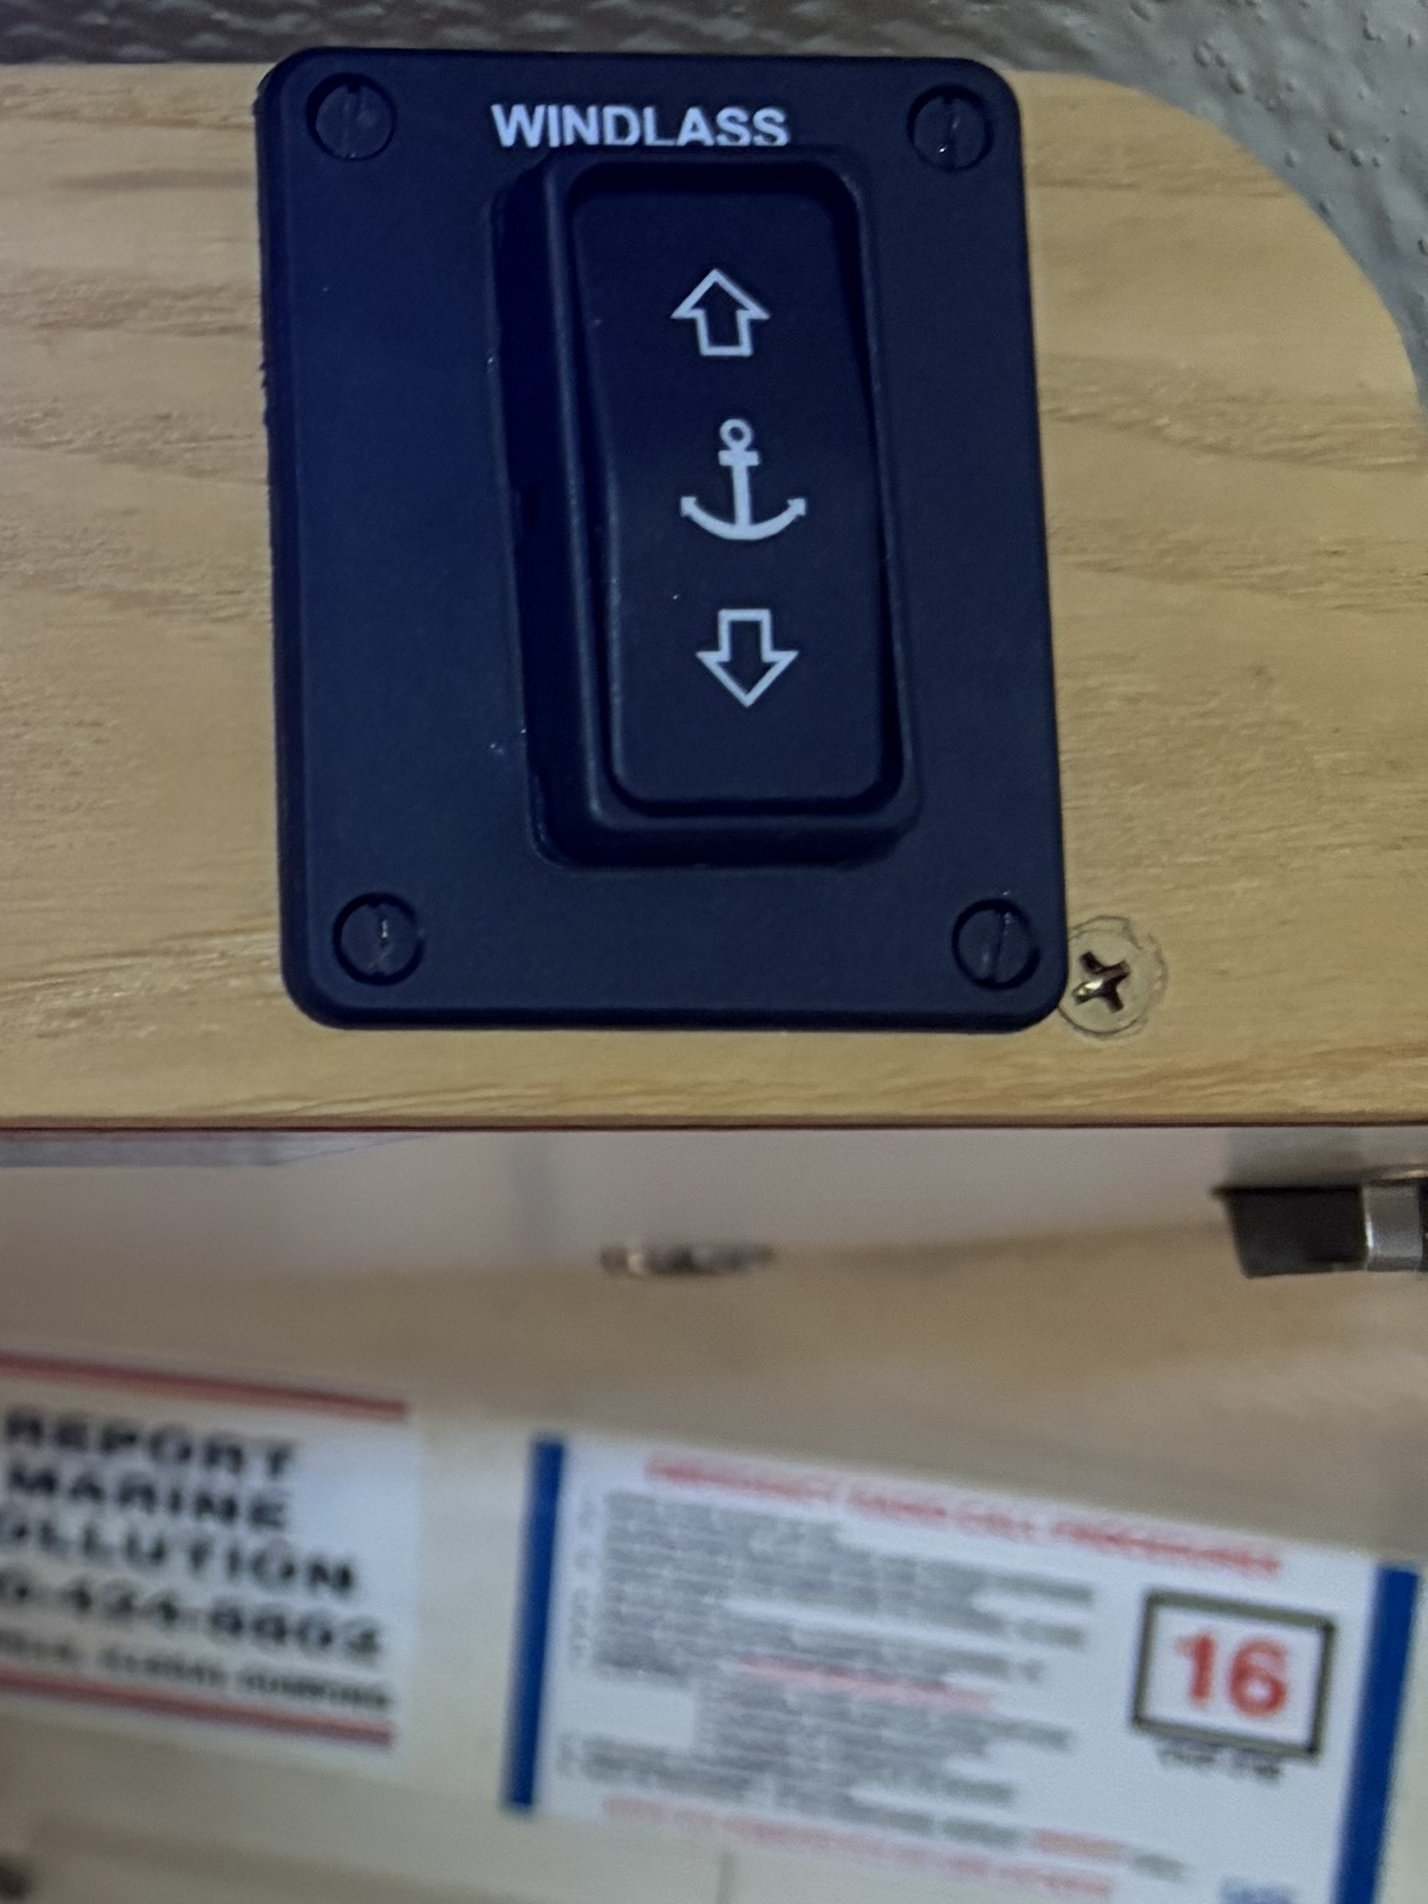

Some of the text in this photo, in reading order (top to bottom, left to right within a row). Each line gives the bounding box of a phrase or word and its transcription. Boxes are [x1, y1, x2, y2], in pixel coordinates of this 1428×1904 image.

[489, 102, 790, 149] WINDLASS
[5, 1407, 297, 1480] REPORT
[7, 1460, 288, 1531] MARINE
[1173, 1626, 1293, 1719] 16
